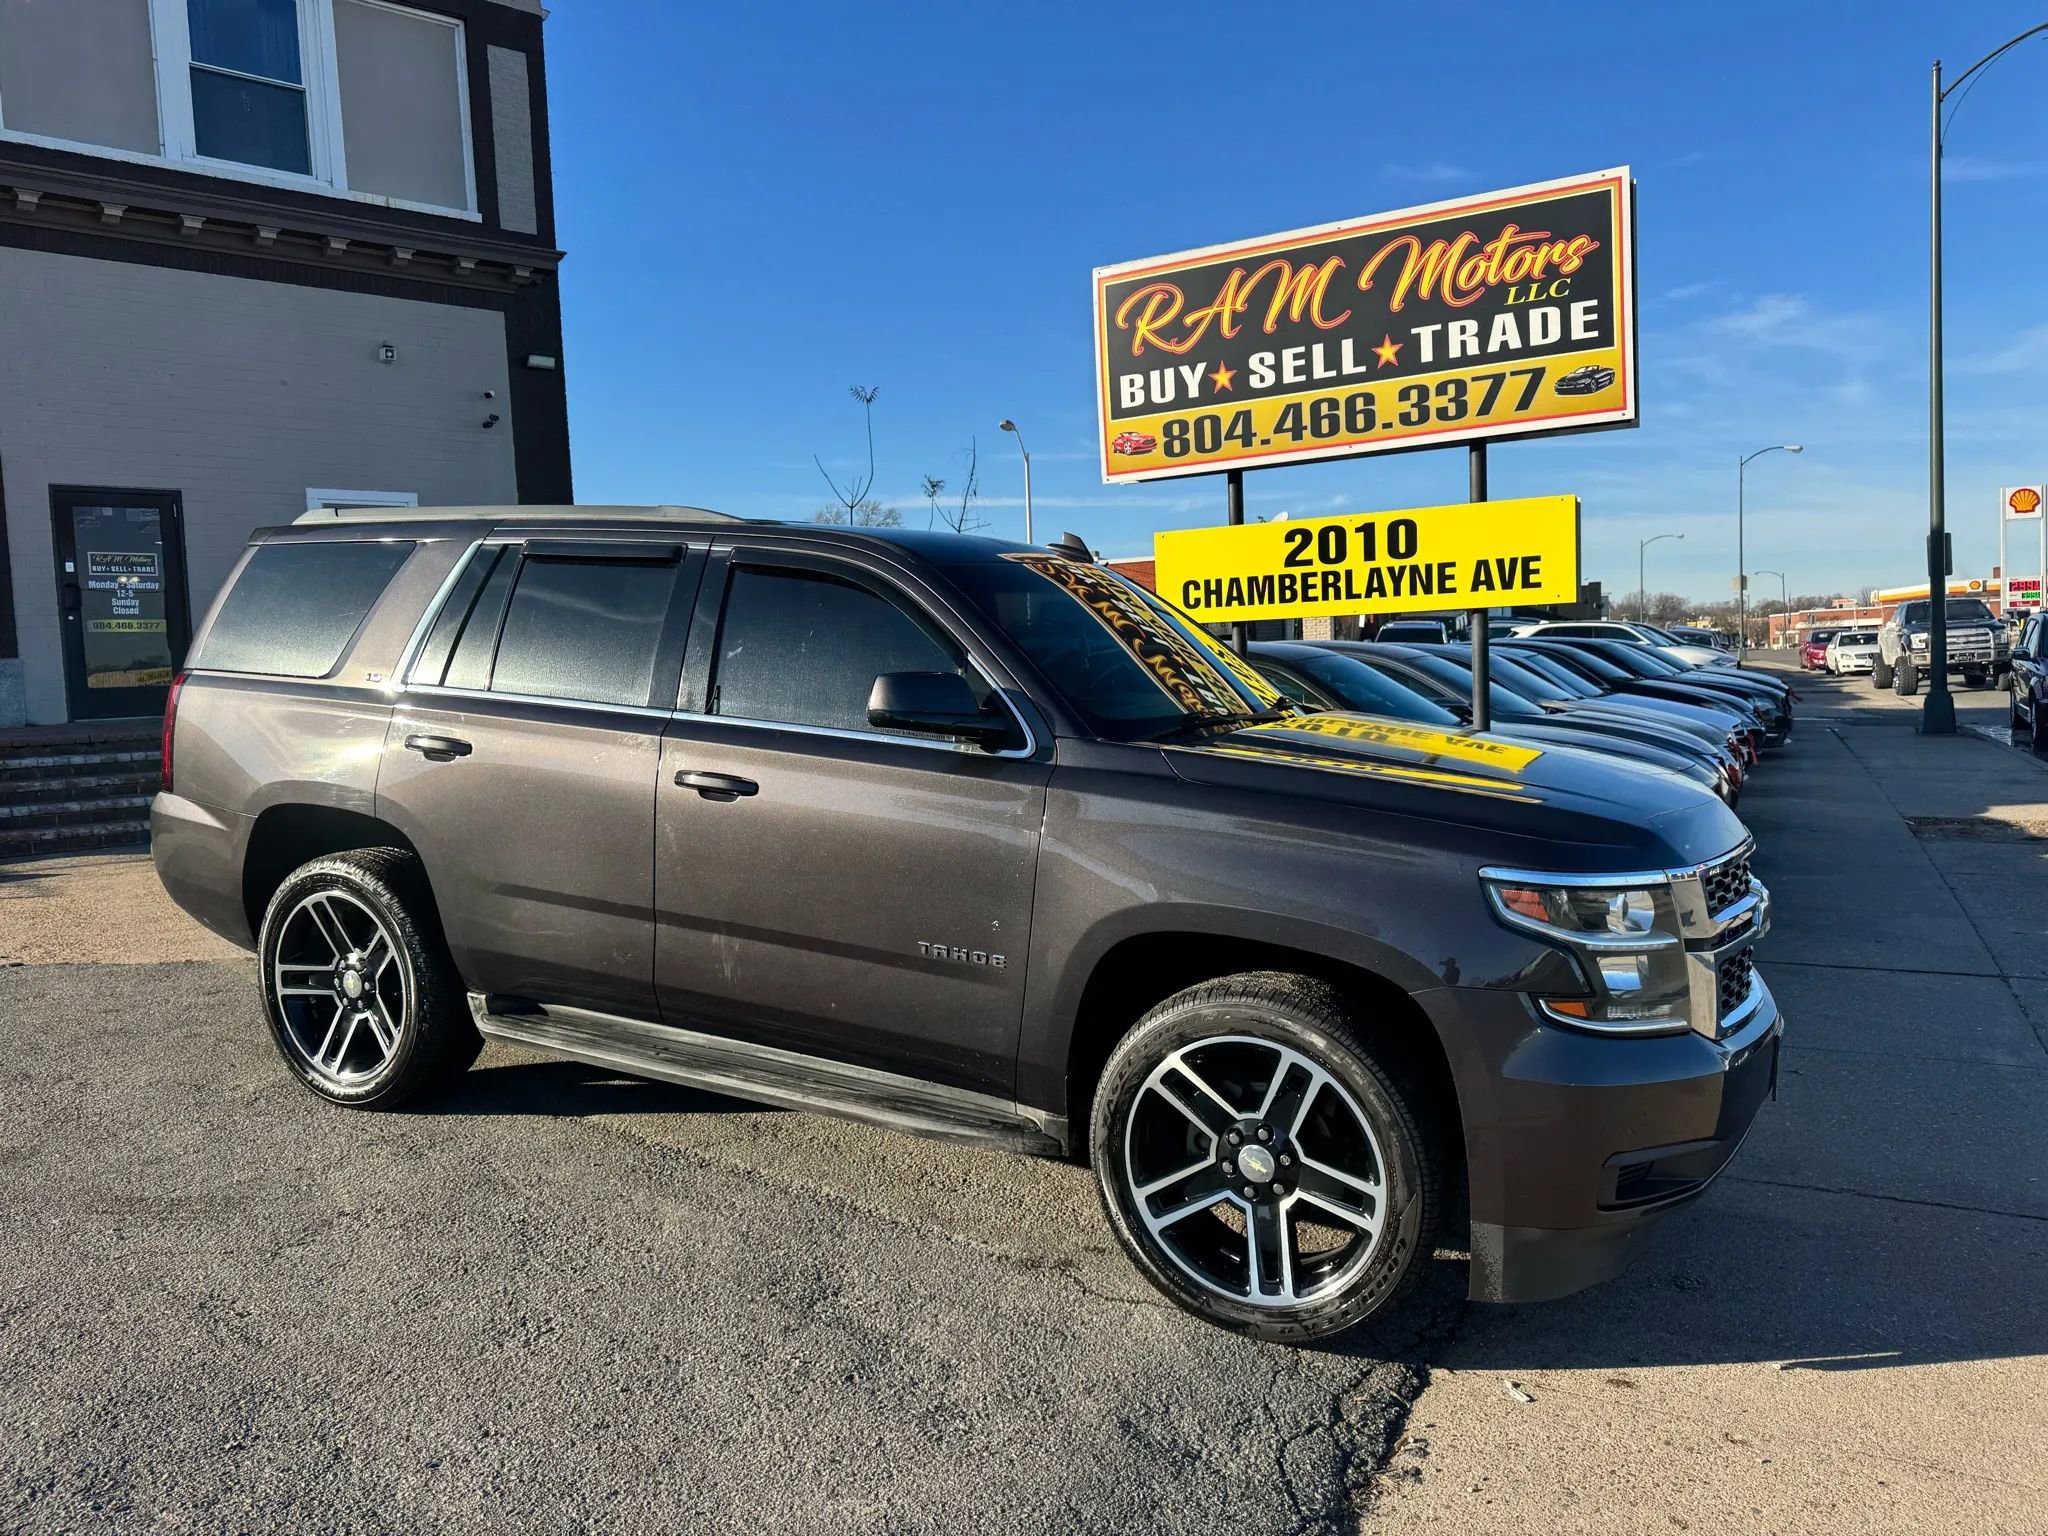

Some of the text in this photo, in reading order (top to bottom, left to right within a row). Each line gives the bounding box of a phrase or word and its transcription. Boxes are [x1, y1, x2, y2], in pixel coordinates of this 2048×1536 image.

[1357, 223, 1600, 313] Motors
[1504, 277, 1571, 306] LLC
[1120, 299, 1599, 409] BUY SELL TRADE
[1162, 366, 1547, 458] 804.466.3377
[1284, 518, 1418, 568] 2010
[88, 580, 119, 590] Monday
[126, 580, 159, 590] Saturday
[116, 589, 134, 597] 12-5
[1182, 555, 1542, 610] CHAMBERLAYNE AVE
[111, 598, 140, 607] Sunday
[113, 606, 139, 615] Closed
[918, 941, 1007, 969] TAHOE
